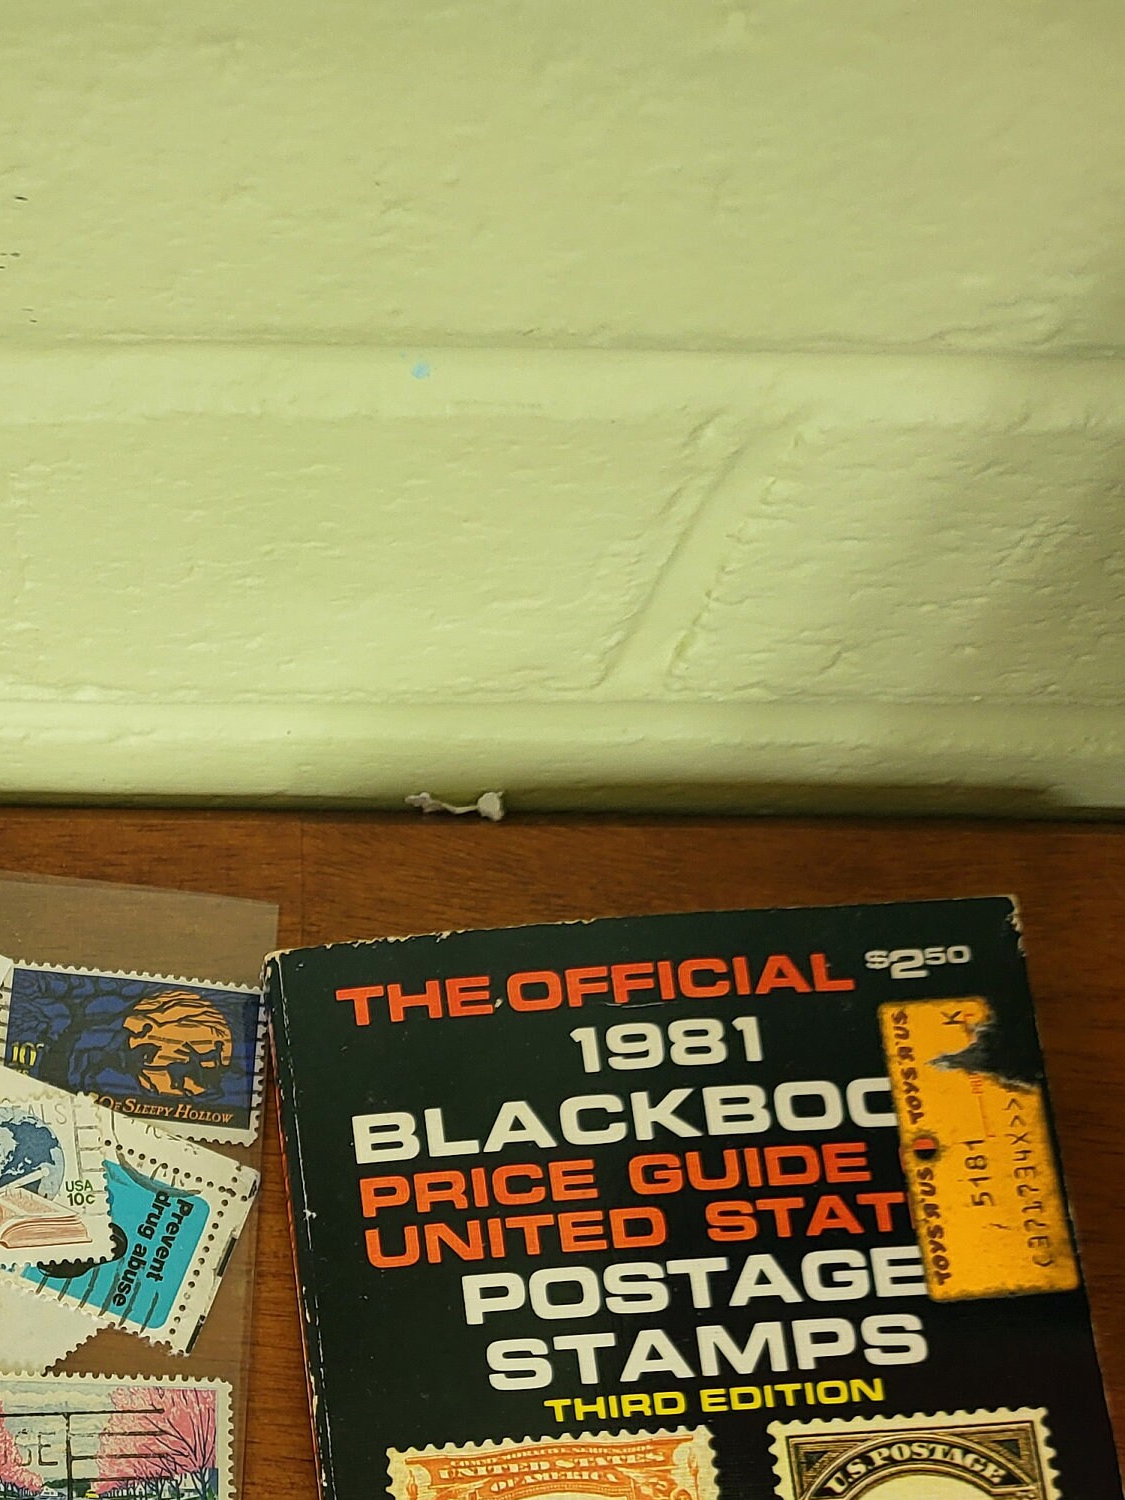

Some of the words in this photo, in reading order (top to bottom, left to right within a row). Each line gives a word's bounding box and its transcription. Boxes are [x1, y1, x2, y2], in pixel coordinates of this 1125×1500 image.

[335, 976, 494, 1027] THE
[506, 953, 856, 1013] OFFICIAL
[569, 1016, 765, 1074] 1981
[351, 1076, 899, 1165] BLACKBOO
[65, 1179, 94, 1193] USA
[359, 1159, 599, 1218] PRICE
[628, 1142, 873, 1196] GUIDE
[136, 1190, 170, 1241] drug
[145, 1198, 195, 1283] Prevent
[365, 1206, 668, 1268] UNITED
[704, 1191, 917, 1242] STAT
[112, 1242, 148, 1308] abuse
[461, 1245, 930, 1325] POSTAGE
[486, 1312, 929, 1391] STAMPS
[543, 1391, 687, 1423] THIRD
[700, 1377, 886, 1413] EDITION
[438, 1457, 550, 1480] UNITED
[555, 1451, 666, 1470] STATES
[824, 1456, 876, 1495] U.S.
[874, 1441, 1009, 1484] POSTAGE
